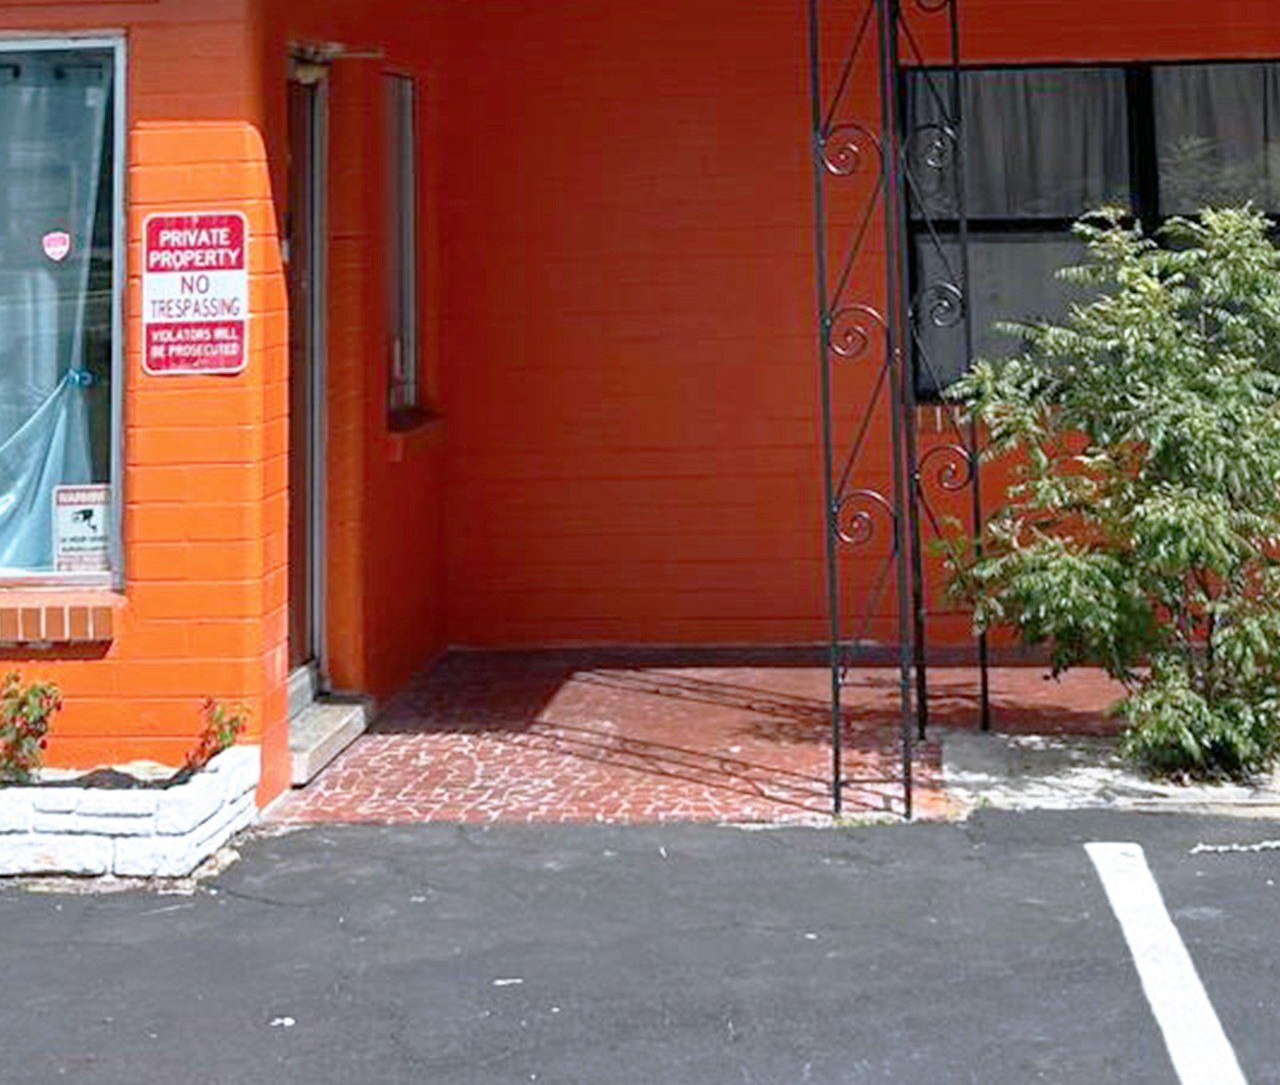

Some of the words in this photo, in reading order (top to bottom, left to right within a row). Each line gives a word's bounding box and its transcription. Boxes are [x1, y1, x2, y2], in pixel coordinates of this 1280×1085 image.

[159, 227, 231, 247] PRIVATE
[149, 248, 240, 268] PROPERTY
[180, 274, 210, 294] NO
[150, 298, 240, 318] TRESPASSING
[151, 327, 211, 342] VIOLATORS
[214, 326, 238, 340] WILL
[150, 345, 166, 357] BE
[169, 343, 239, 357] PROSECUTED
